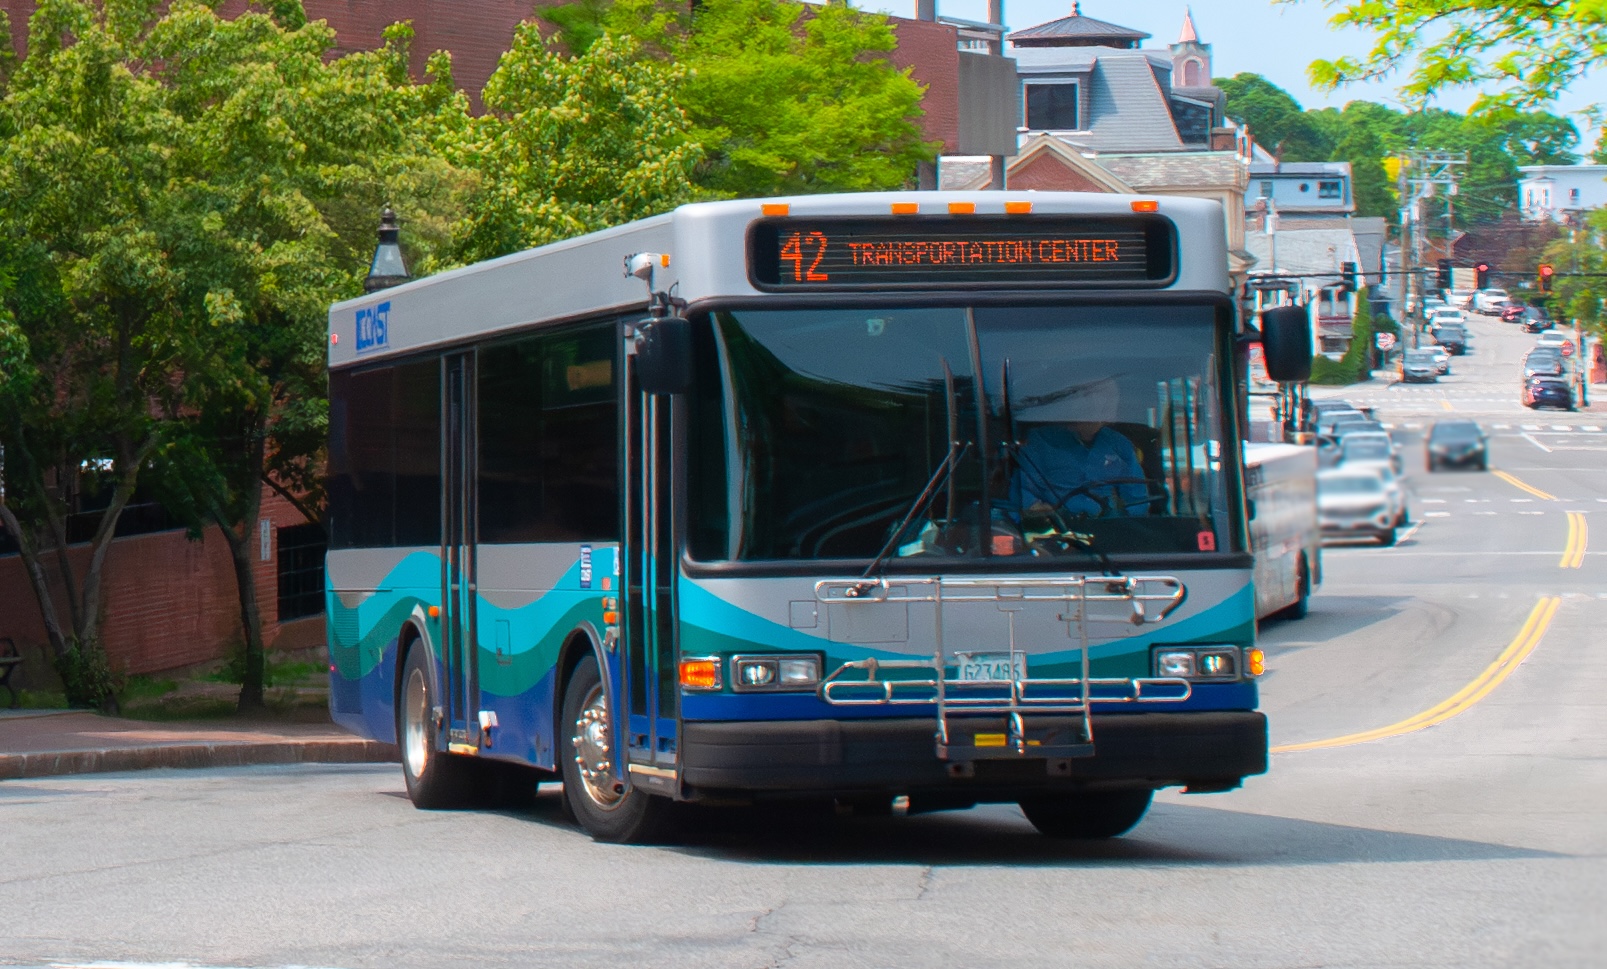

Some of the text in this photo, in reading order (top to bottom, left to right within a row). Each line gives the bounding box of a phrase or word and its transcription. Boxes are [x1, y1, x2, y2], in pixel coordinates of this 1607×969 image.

[781, 231, 1119, 281] 42 TRANSPORTATION CENTER
